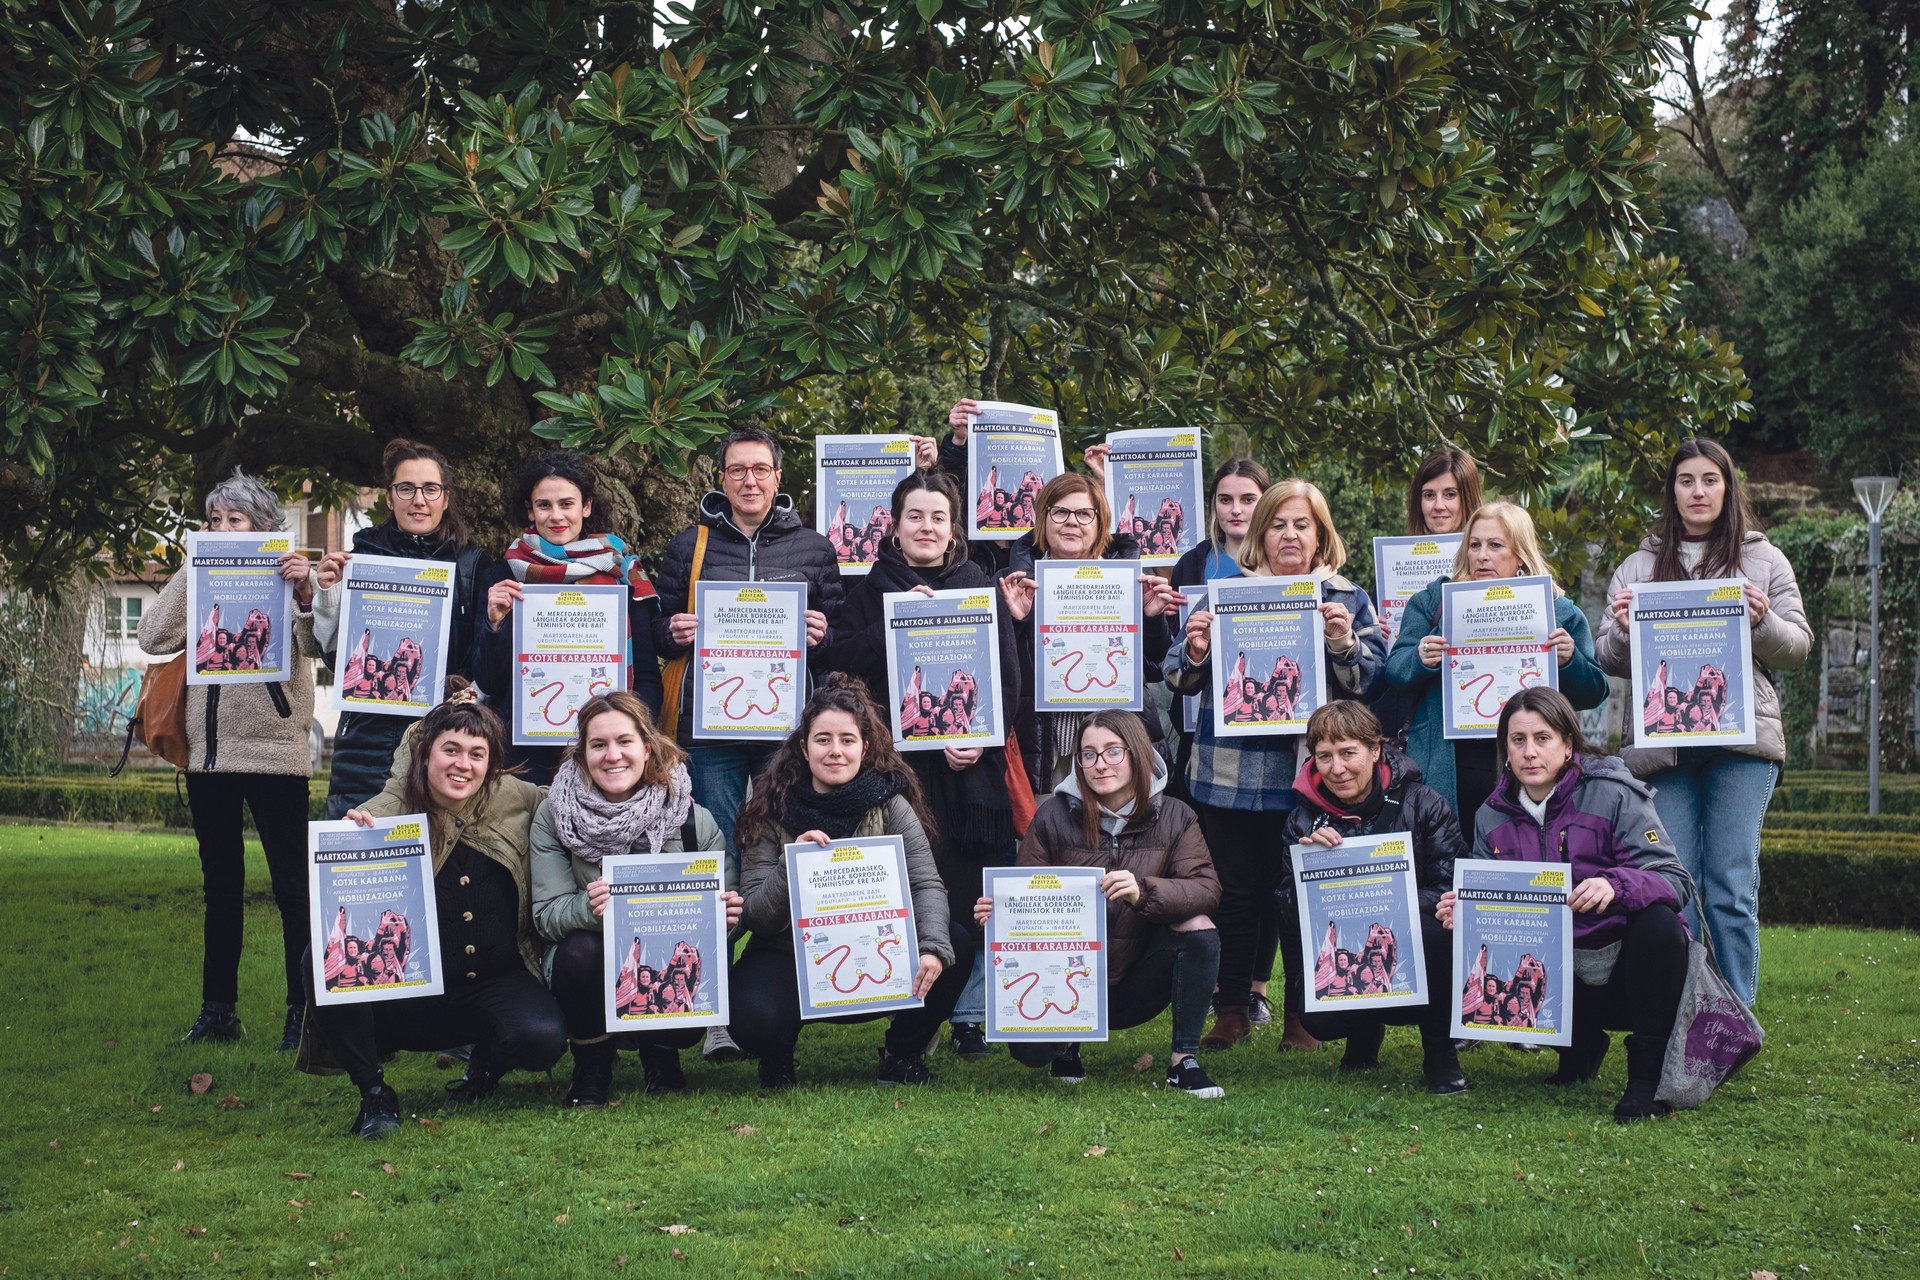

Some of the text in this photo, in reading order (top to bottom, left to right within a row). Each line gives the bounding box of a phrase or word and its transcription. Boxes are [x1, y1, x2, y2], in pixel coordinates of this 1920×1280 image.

[1019, 426, 1055, 436] AIARALDEAN
[347, 580, 390, 591] MARTXOAK
[398, 584, 446, 595] AIARALDEAN
[361, 604, 429, 616] KOTXE KARABANA
[727, 606, 784, 614] MERCEDARIASEKO
[1216, 604, 1258, 612] MARTXOAK
[1267, 601, 1315, 610] AIARALDEAN
[1635, 610, 1681, 619] MARTXOAK
[1690, 607, 1742, 616] AIARALDEAN
[364, 619, 423, 630] MOBILIZAZIOAK
[891, 618, 934, 627] MARTXOAK
[942, 615, 990, 624] AIARALDEAN
[1259, 625, 1301, 633] KARABANA
[935, 638, 976, 647] KARABANA
[1653, 632, 1727, 642] KOTXE KARABANA
[1237, 639, 1297, 648] MOBILIZAZIOAK
[709, 649, 791, 658] KOTXE KARABANA
[1457, 644, 1542, 655] KOTXE KARABANA
[1659, 647, 1723, 657] MOBILIZAZIOAK
[528, 654, 612, 662] KOTXE KARABANA
[913, 653, 973, 663] MOBILIZAZIOAK
[1381, 839, 1404, 847] DENON
[315, 852, 359, 863] MARTXOAK
[368, 846, 422, 858] AIARALDEAN
[822, 864, 885, 875] MERCEDARIASEKO
[1301, 868, 1346, 880] MARTXOAK
[1355, 862, 1407, 874] AIARALDEAN
[331, 873, 407, 887] KOTXE KARABANA
[808, 870, 889, 883] LANGILEAK BORROKAN,
[610, 884, 656, 893] MARTXOAK
[666, 881, 717, 890] AIARALDEAN
[813, 879, 855, 888] FEMINISTOK
[337, 890, 404, 903] MOBILIZAZIOAK
[821, 890, 864, 899] MARTXOAREN
[1320, 888, 1393, 902] KOTXE KARABANA
[1459, 890, 1564, 903] MARTXOAK 8 AIARALDEAN
[627, 907, 702, 917] KOTXE KARABANA
[1326, 904, 1390, 918] MOBILIZAZIOAK
[808, 915, 840, 926] KOTXE
[843, 909, 898, 923] KARABANA
[1475, 917, 1548, 928] KOTXE KARABANA
[633, 923, 697, 933] MOBILIZAZIOAK
[1480, 933, 1543, 944] MOBILIZAZIOAK
[1000, 942, 1091, 951] KOTXE KARABANA
